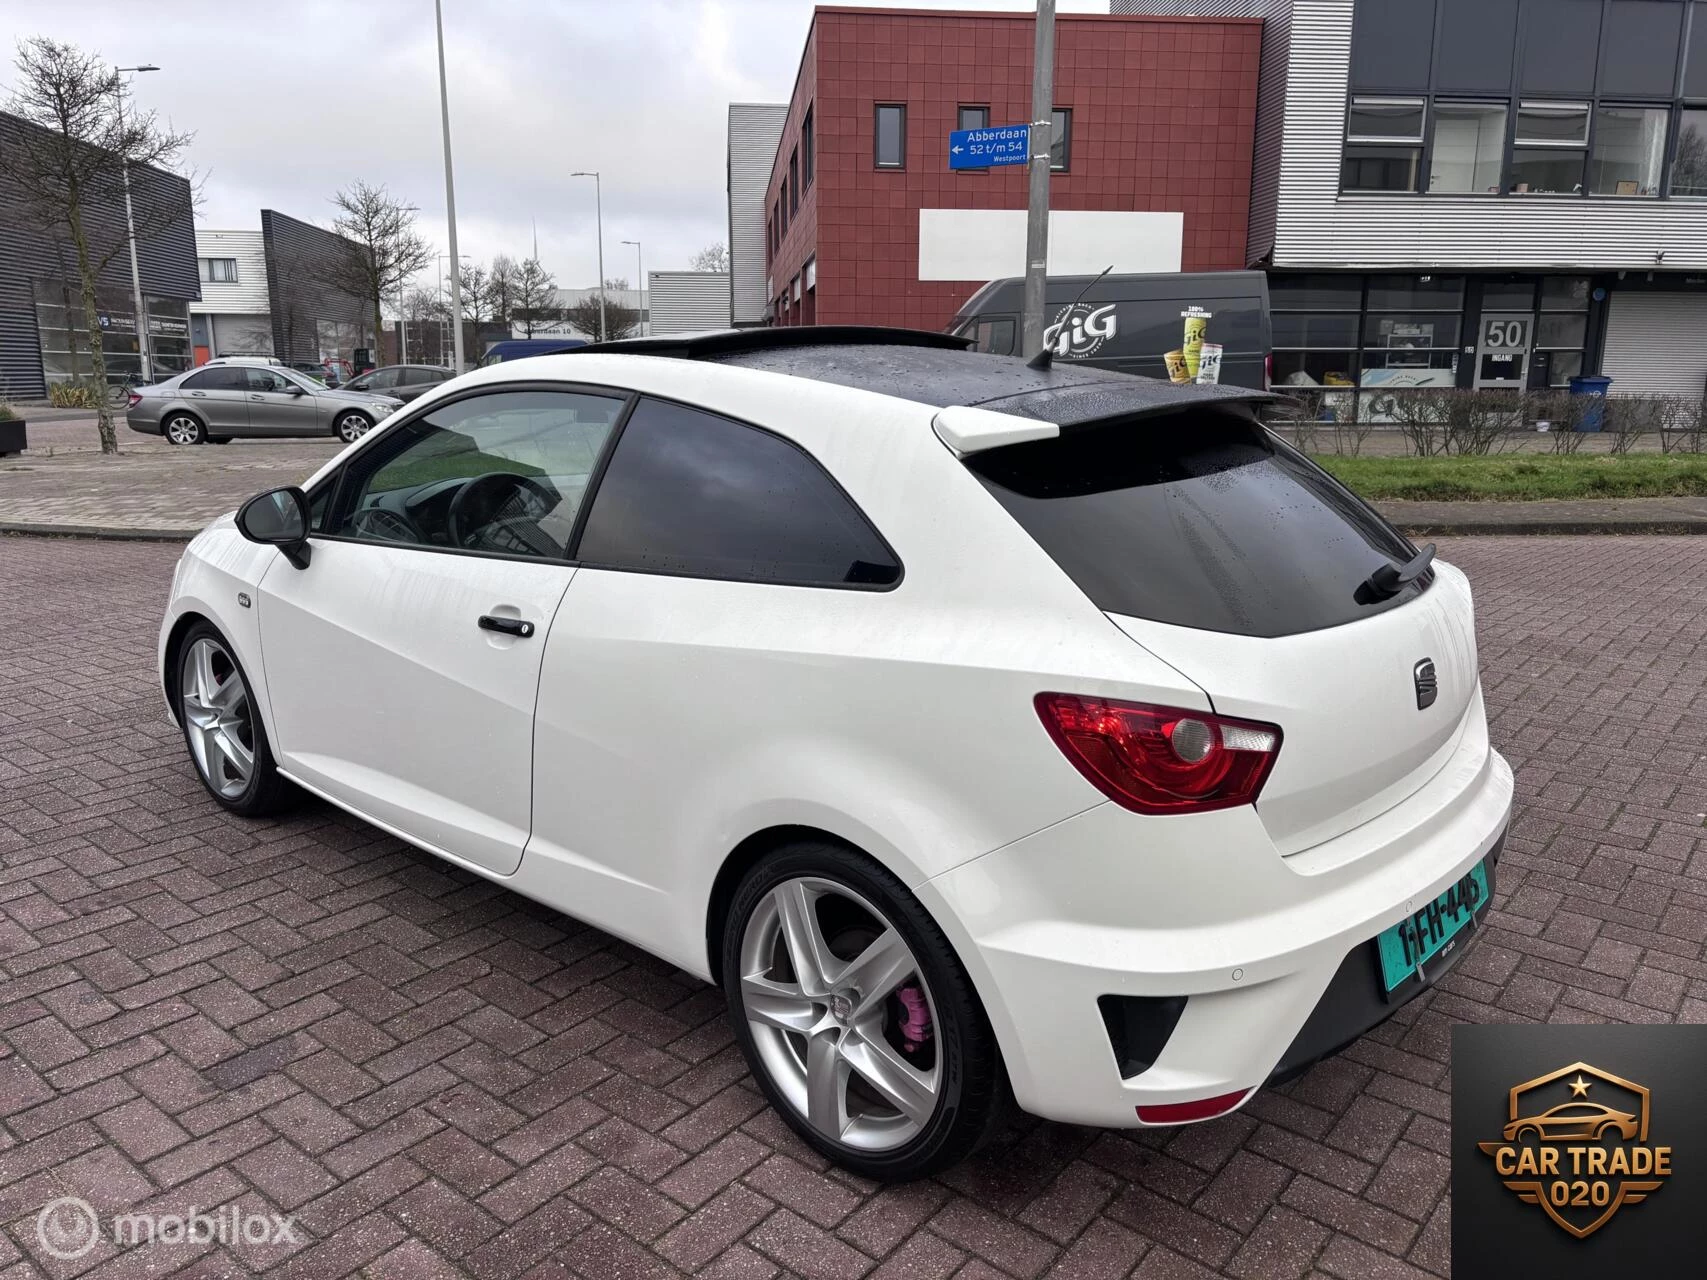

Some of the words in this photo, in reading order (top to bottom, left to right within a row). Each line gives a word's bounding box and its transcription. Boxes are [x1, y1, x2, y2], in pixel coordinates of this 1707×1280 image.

[967, 128, 1027, 142] Abberdaan
[969, 145, 984, 155] 52
[986, 143, 1006, 153] t/m
[1008, 141, 1022, 152] 54
[993, 154, 1026, 162] Westpoort
[1487, 321, 1522, 347] 50
